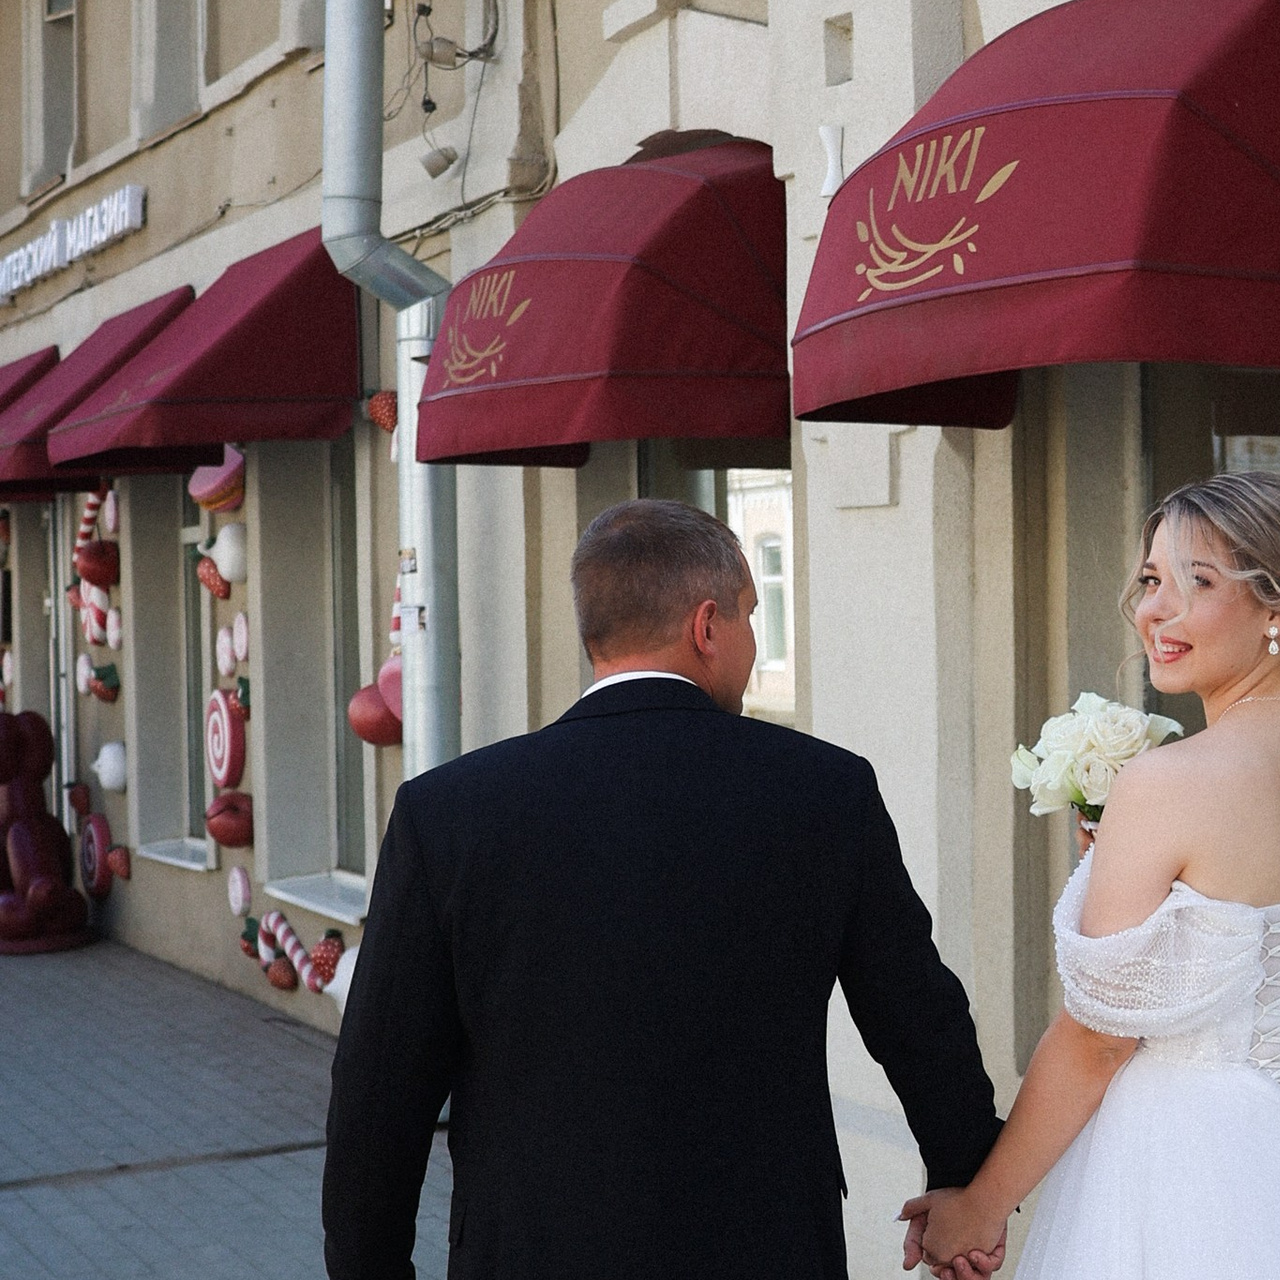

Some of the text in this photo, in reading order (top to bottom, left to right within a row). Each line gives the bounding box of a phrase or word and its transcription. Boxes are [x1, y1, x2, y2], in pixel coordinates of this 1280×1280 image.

[886, 125, 986, 212] NIKI
[66, 184, 131, 262] МАГАЗИН
[462, 270, 516, 325] NIKI
